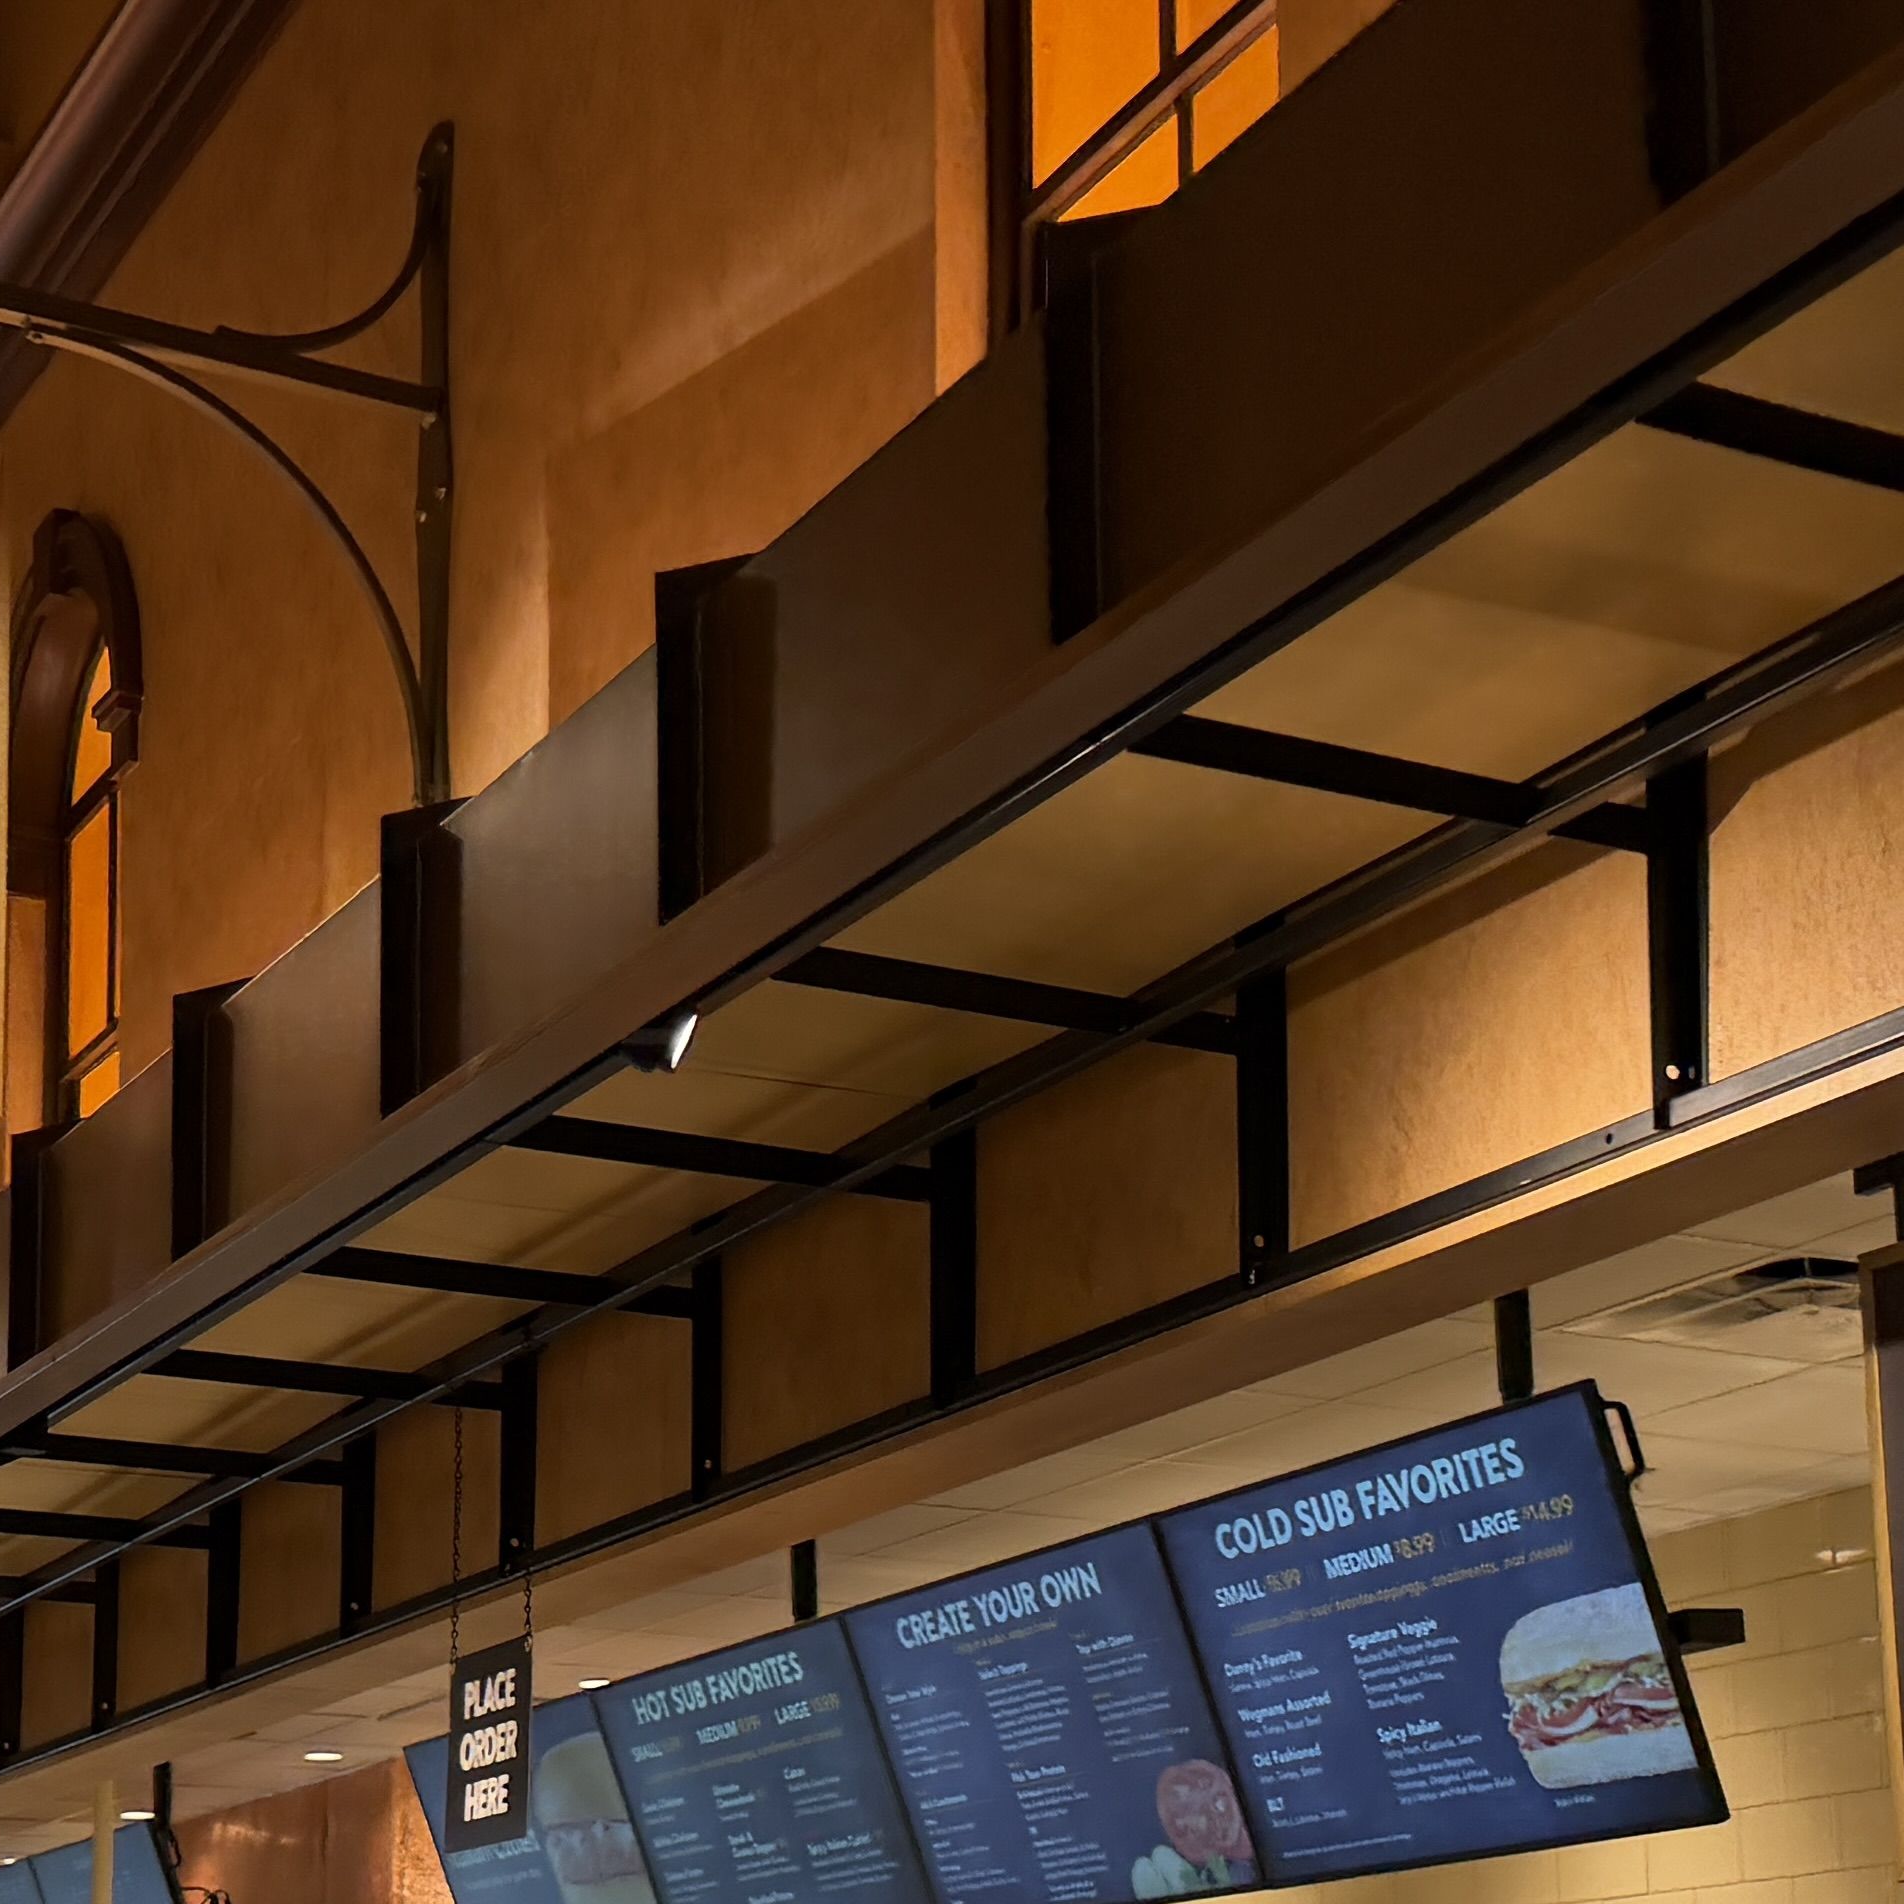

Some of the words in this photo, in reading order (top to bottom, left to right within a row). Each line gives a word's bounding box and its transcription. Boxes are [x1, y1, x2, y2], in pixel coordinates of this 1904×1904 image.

[1215, 1507, 1293, 1560] COLD
[1294, 1488, 1355, 1538] SUB
[1356, 1438, 1525, 1520] FAVORITES
[1215, 1578, 1267, 1608] SMALL
[1323, 1543, 1394, 1580] MEDIUM
[1458, 1508, 1521, 1544] LARGE
[896, 1600, 976, 1649] CREATE
[971, 1581, 1040, 1627] YOUR
[1040, 1562, 1102, 1608] OWN
[464, 1668, 517, 1720] PLACE
[632, 1690, 671, 1726] HOT
[670, 1680, 708, 1715] SUB
[706, 1651, 804, 1705] FAVORITES
[459, 1720, 518, 1772] ORDER
[696, 1720, 738, 1745] MEDIUM
[774, 1701, 812, 1725] LARGE
[463, 1774, 510, 1822] HERE
